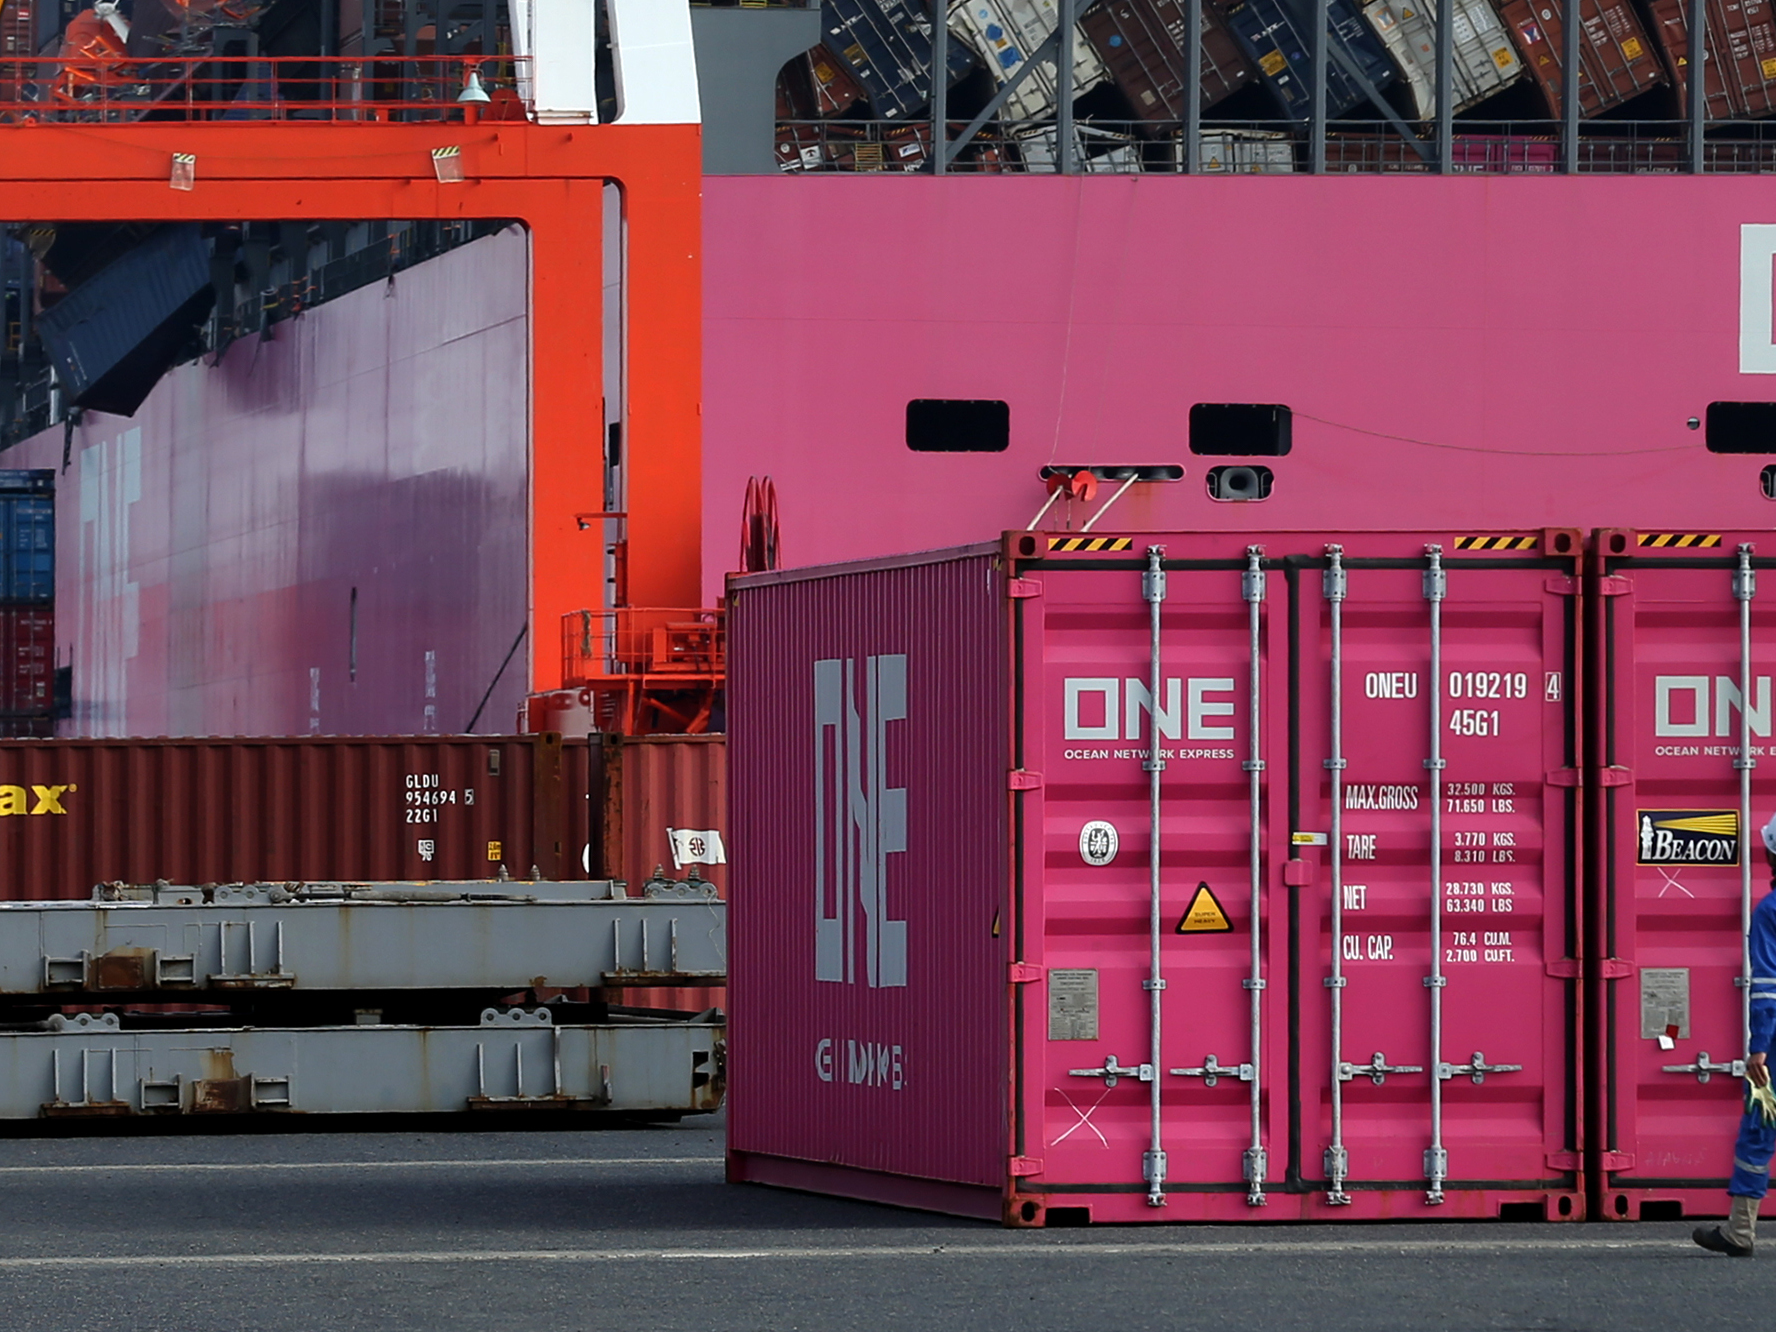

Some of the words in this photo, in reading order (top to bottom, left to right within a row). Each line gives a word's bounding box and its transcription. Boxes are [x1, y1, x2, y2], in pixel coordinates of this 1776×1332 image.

[1365, 672, 1417, 698] ONEU
[1450, 672, 1527, 698] 019219
[1546, 673, 1560, 700] 4
[1064, 678, 1234, 740] ONE
[1450, 710, 1500, 736] 45G1
[1064, 749, 1108, 759] OCEAN
[1114, 749, 1174, 759] NETWRK
[1180, 749, 1234, 759] EXPRESS
[1655, 746, 1699, 756] OCEAN
[1704, 746, 1765, 756] NETWRK
[406, 774, 439, 788] GLDU
[405, 791, 456, 805] 954694
[465, 789, 474, 805] 5
[1346, 785, 1418, 809] MAX.GROSS
[1447, 783, 1485, 795] 32.500
[1492, 783, 1515, 795] KGS.
[1447, 799, 1485, 813] 71.650
[1492, 799, 1515, 813] LBS.
[405, 809, 438, 823] 22G1
[814, 653, 906, 988] ONE
[1347, 835, 1376, 860] TARE
[1455, 832, 1485, 846] 3.770
[1493, 832, 1516, 846] KGS.
[1655, 830, 1737, 860] BEACON
[1454, 850, 1485, 863] 8.310
[1343, 885, 1366, 910] NET
[1446, 882, 1484, 895] 28.730
[1491, 882, 1515, 895] KGS.
[1446, 899, 1485, 913] 63.340
[1343, 935, 1363, 960] CU.
[1367, 935, 1393, 960] CAP.
[1453, 932, 1477, 945] 76.4
[1446, 949, 1477, 963] 2.700
